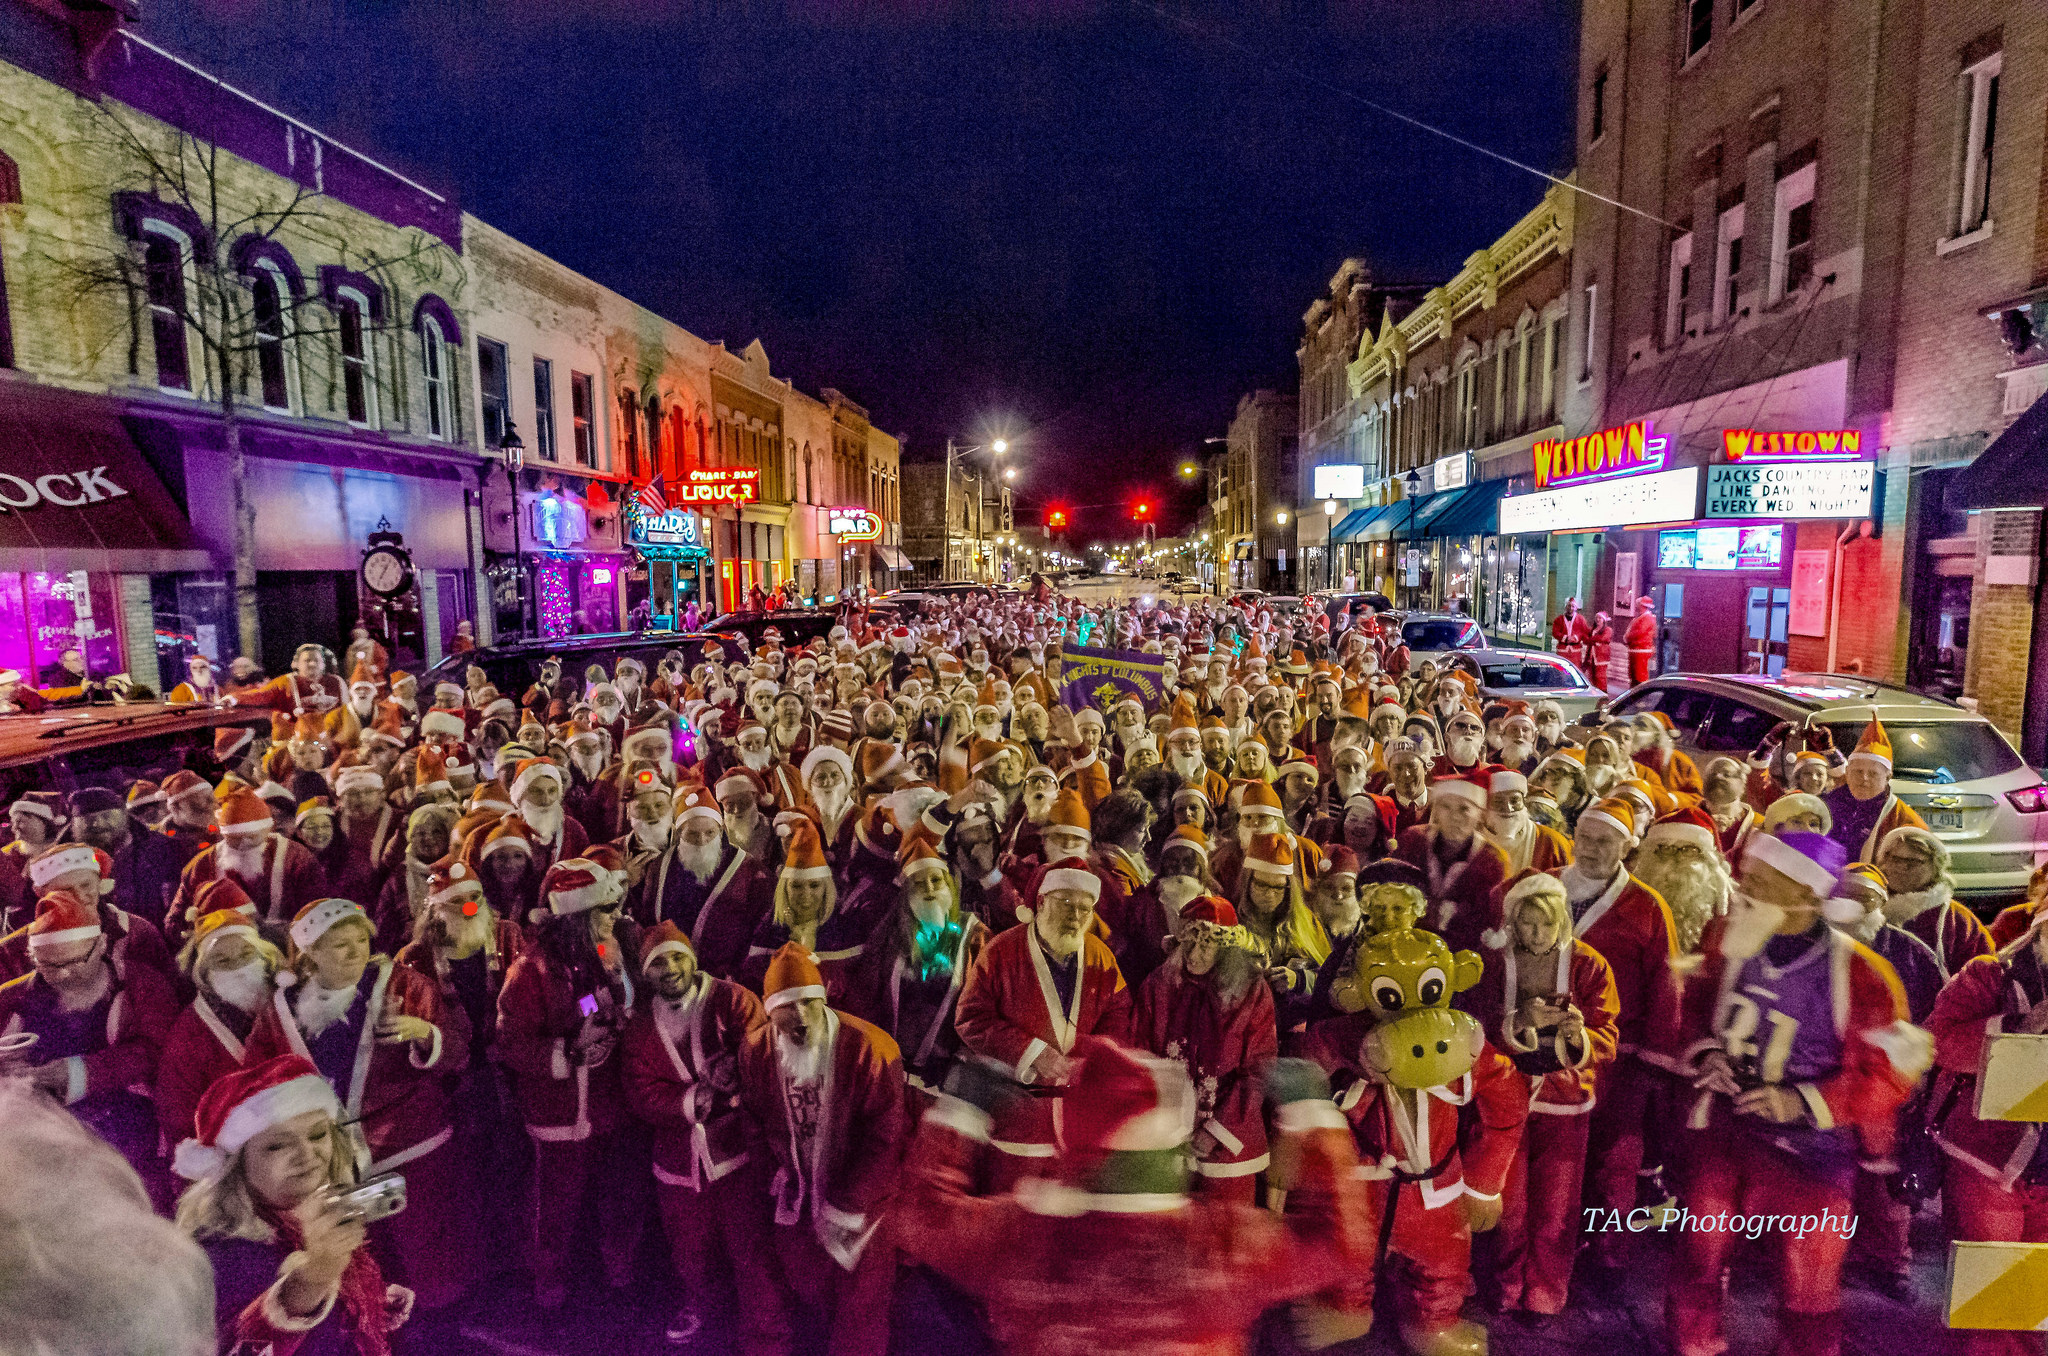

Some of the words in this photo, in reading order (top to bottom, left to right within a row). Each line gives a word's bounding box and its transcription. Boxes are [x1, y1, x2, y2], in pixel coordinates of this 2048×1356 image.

[1533, 420, 1647, 488] WESTOWN
[1723, 429, 1861, 461] WESTOWN
[0, 465, 128, 508] OCK
[1713, 469, 1760, 483] JACKS
[1766, 468, 1832, 482] COUNTRY
[1840, 468, 1869, 480] BAR
[1720, 484, 1751, 498] LINE
[1762, 483, 1826, 497] DANCING
[1839, 483, 1869, 496] 7PM
[1711, 499, 1758, 513] EVERY
[1061, 664, 1099, 687] KNIGHTS
[1112, 666, 1158, 700] COLUMBUS
